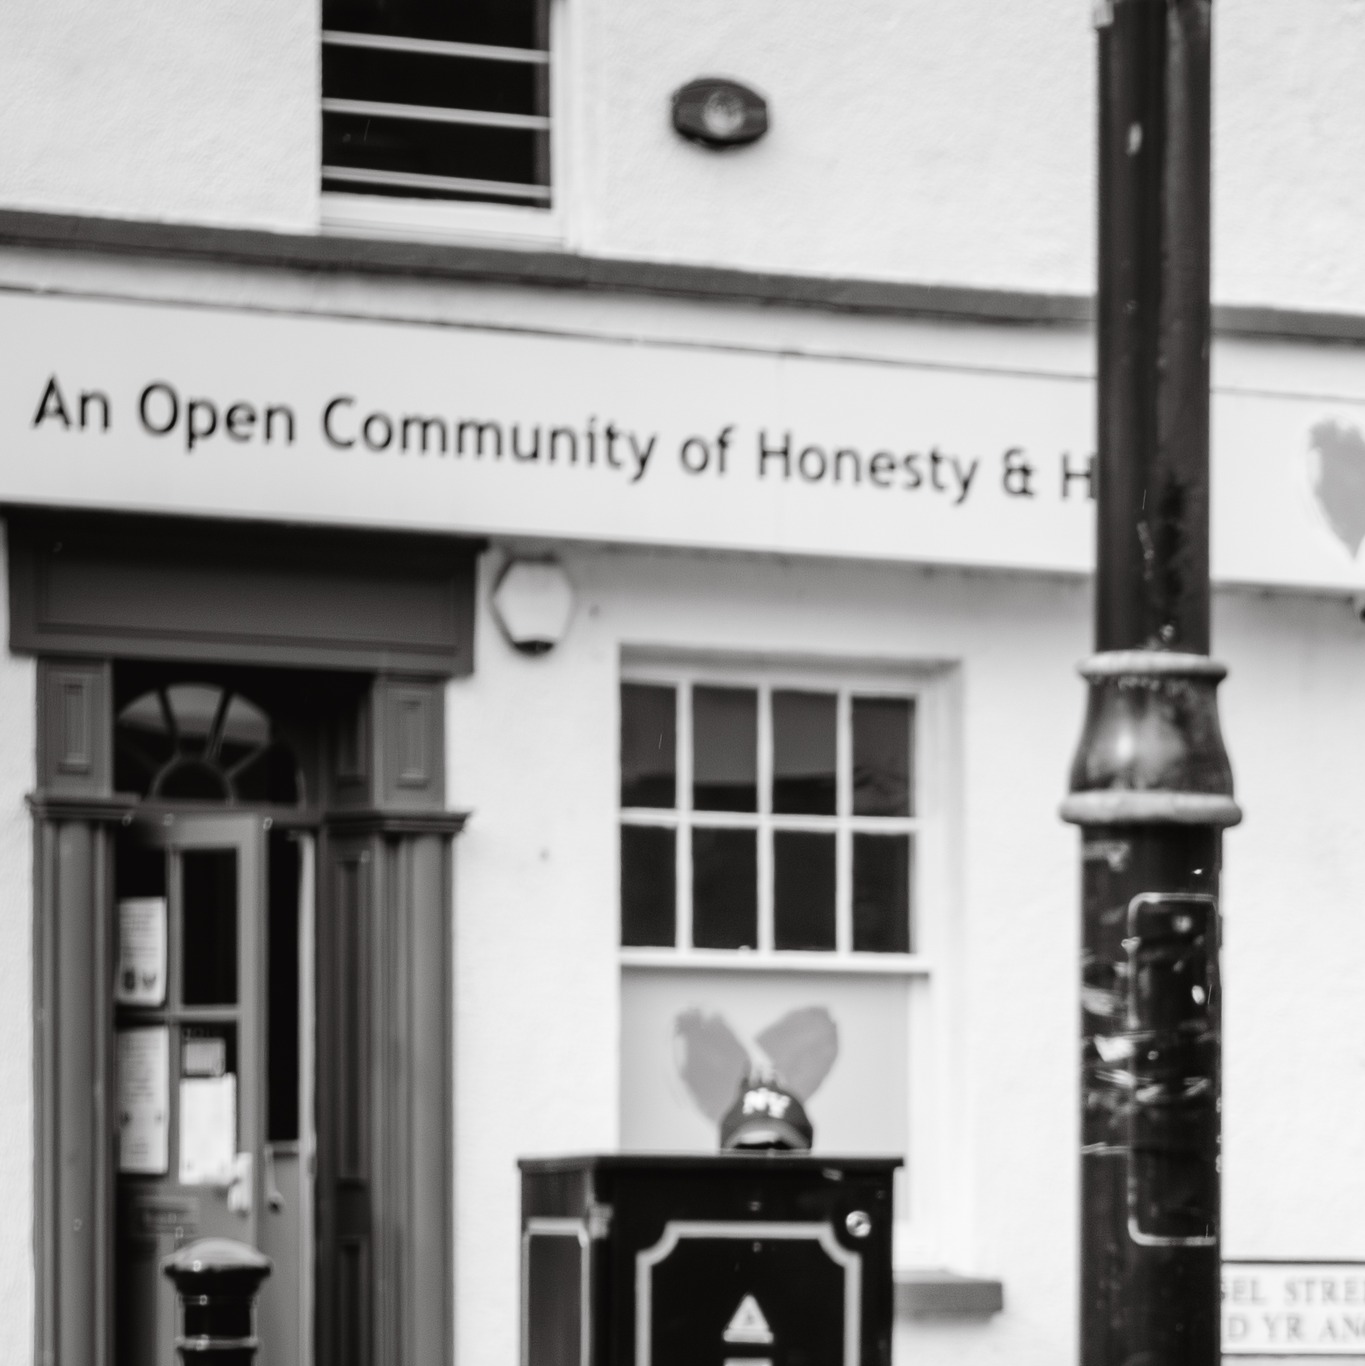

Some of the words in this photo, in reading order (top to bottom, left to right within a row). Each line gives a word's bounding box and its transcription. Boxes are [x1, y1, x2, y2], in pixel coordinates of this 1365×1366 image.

[31, 374, 110, 431] An
[138, 381, 295, 452] Open
[322, 394, 656, 483] Community
[680, 424, 737, 474] of
[757, 429, 979, 506] Honesty
[1001, 450, 1036, 497] &
[742, 1087, 791, 1119] NY
[1263, 1314, 1304, 1341] YR
